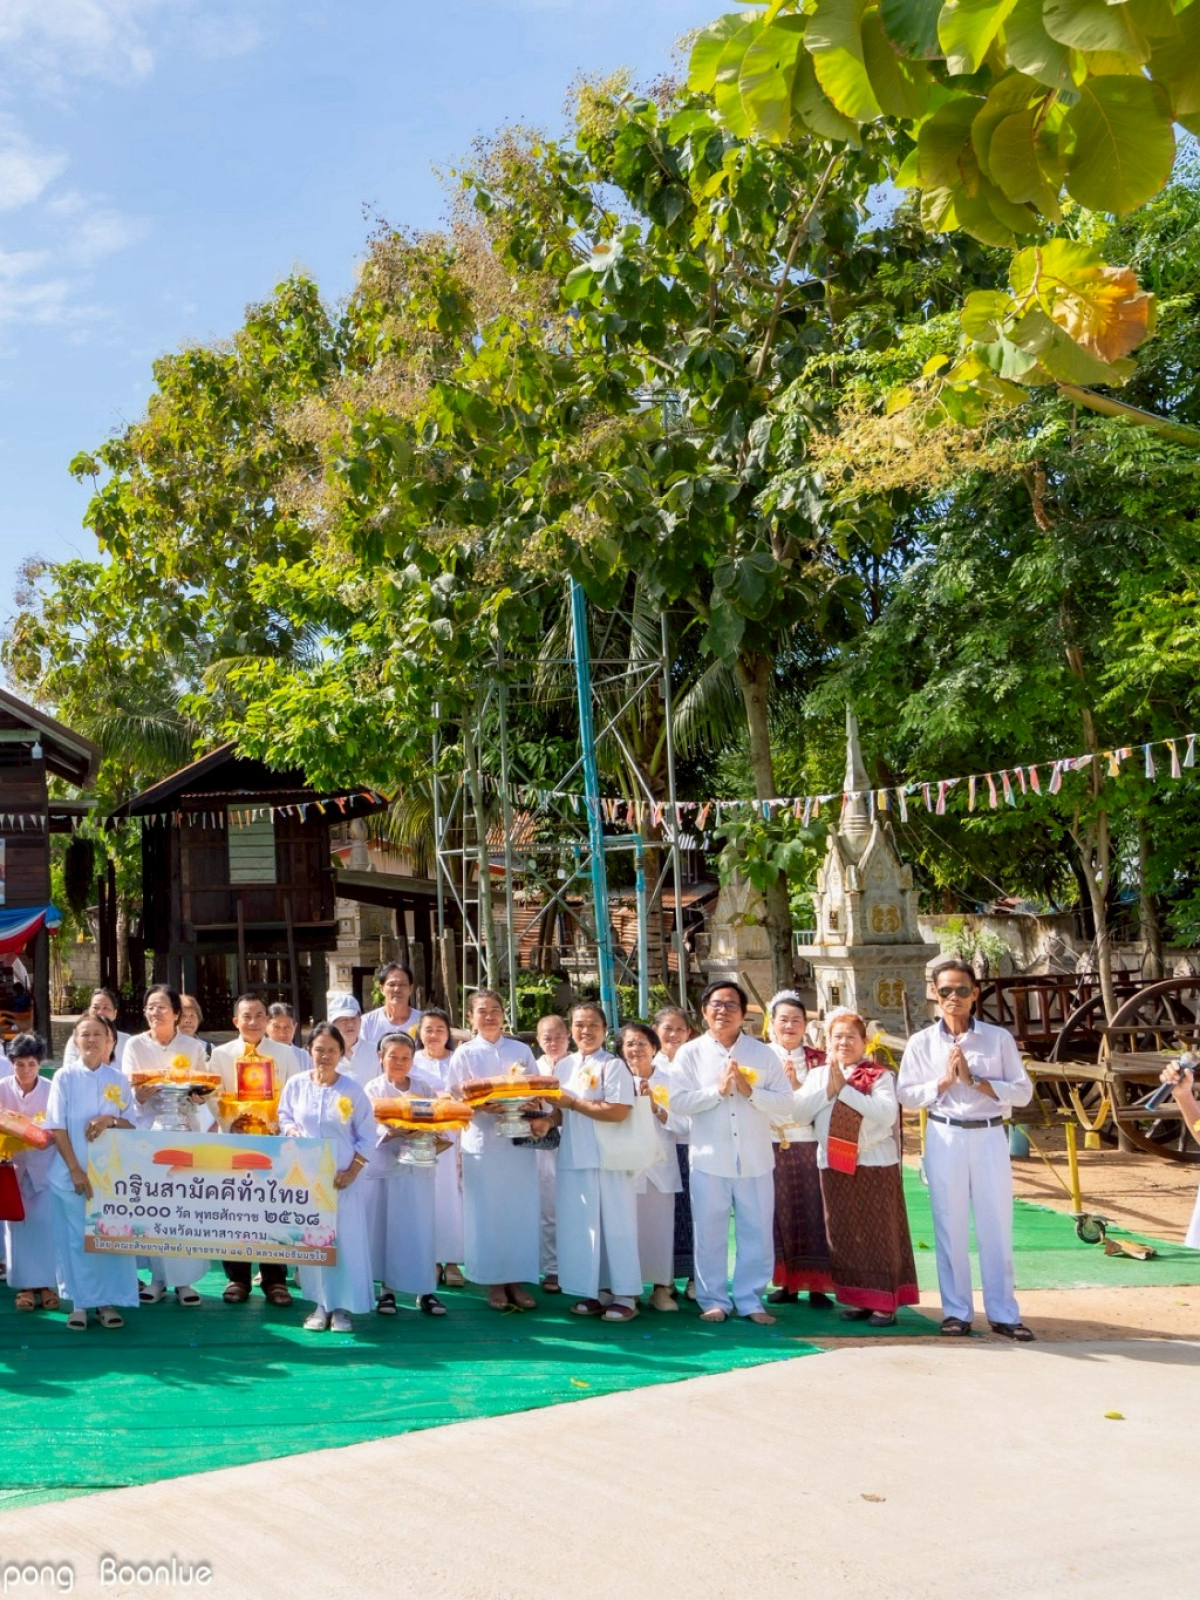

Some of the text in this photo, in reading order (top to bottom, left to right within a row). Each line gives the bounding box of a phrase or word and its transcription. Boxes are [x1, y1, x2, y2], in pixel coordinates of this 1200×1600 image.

[114, 1173, 309, 1204] กฐินสามัคคีทั่วไทย
[103, 1203, 320, 1225] ๓๐,๐๐๐ วัด พุทธศักราช ๒๕๖๘
[154, 1223, 267, 1240] จังหวัดมหาสารคาม
[95, 1238, 111, 1248] โดย
